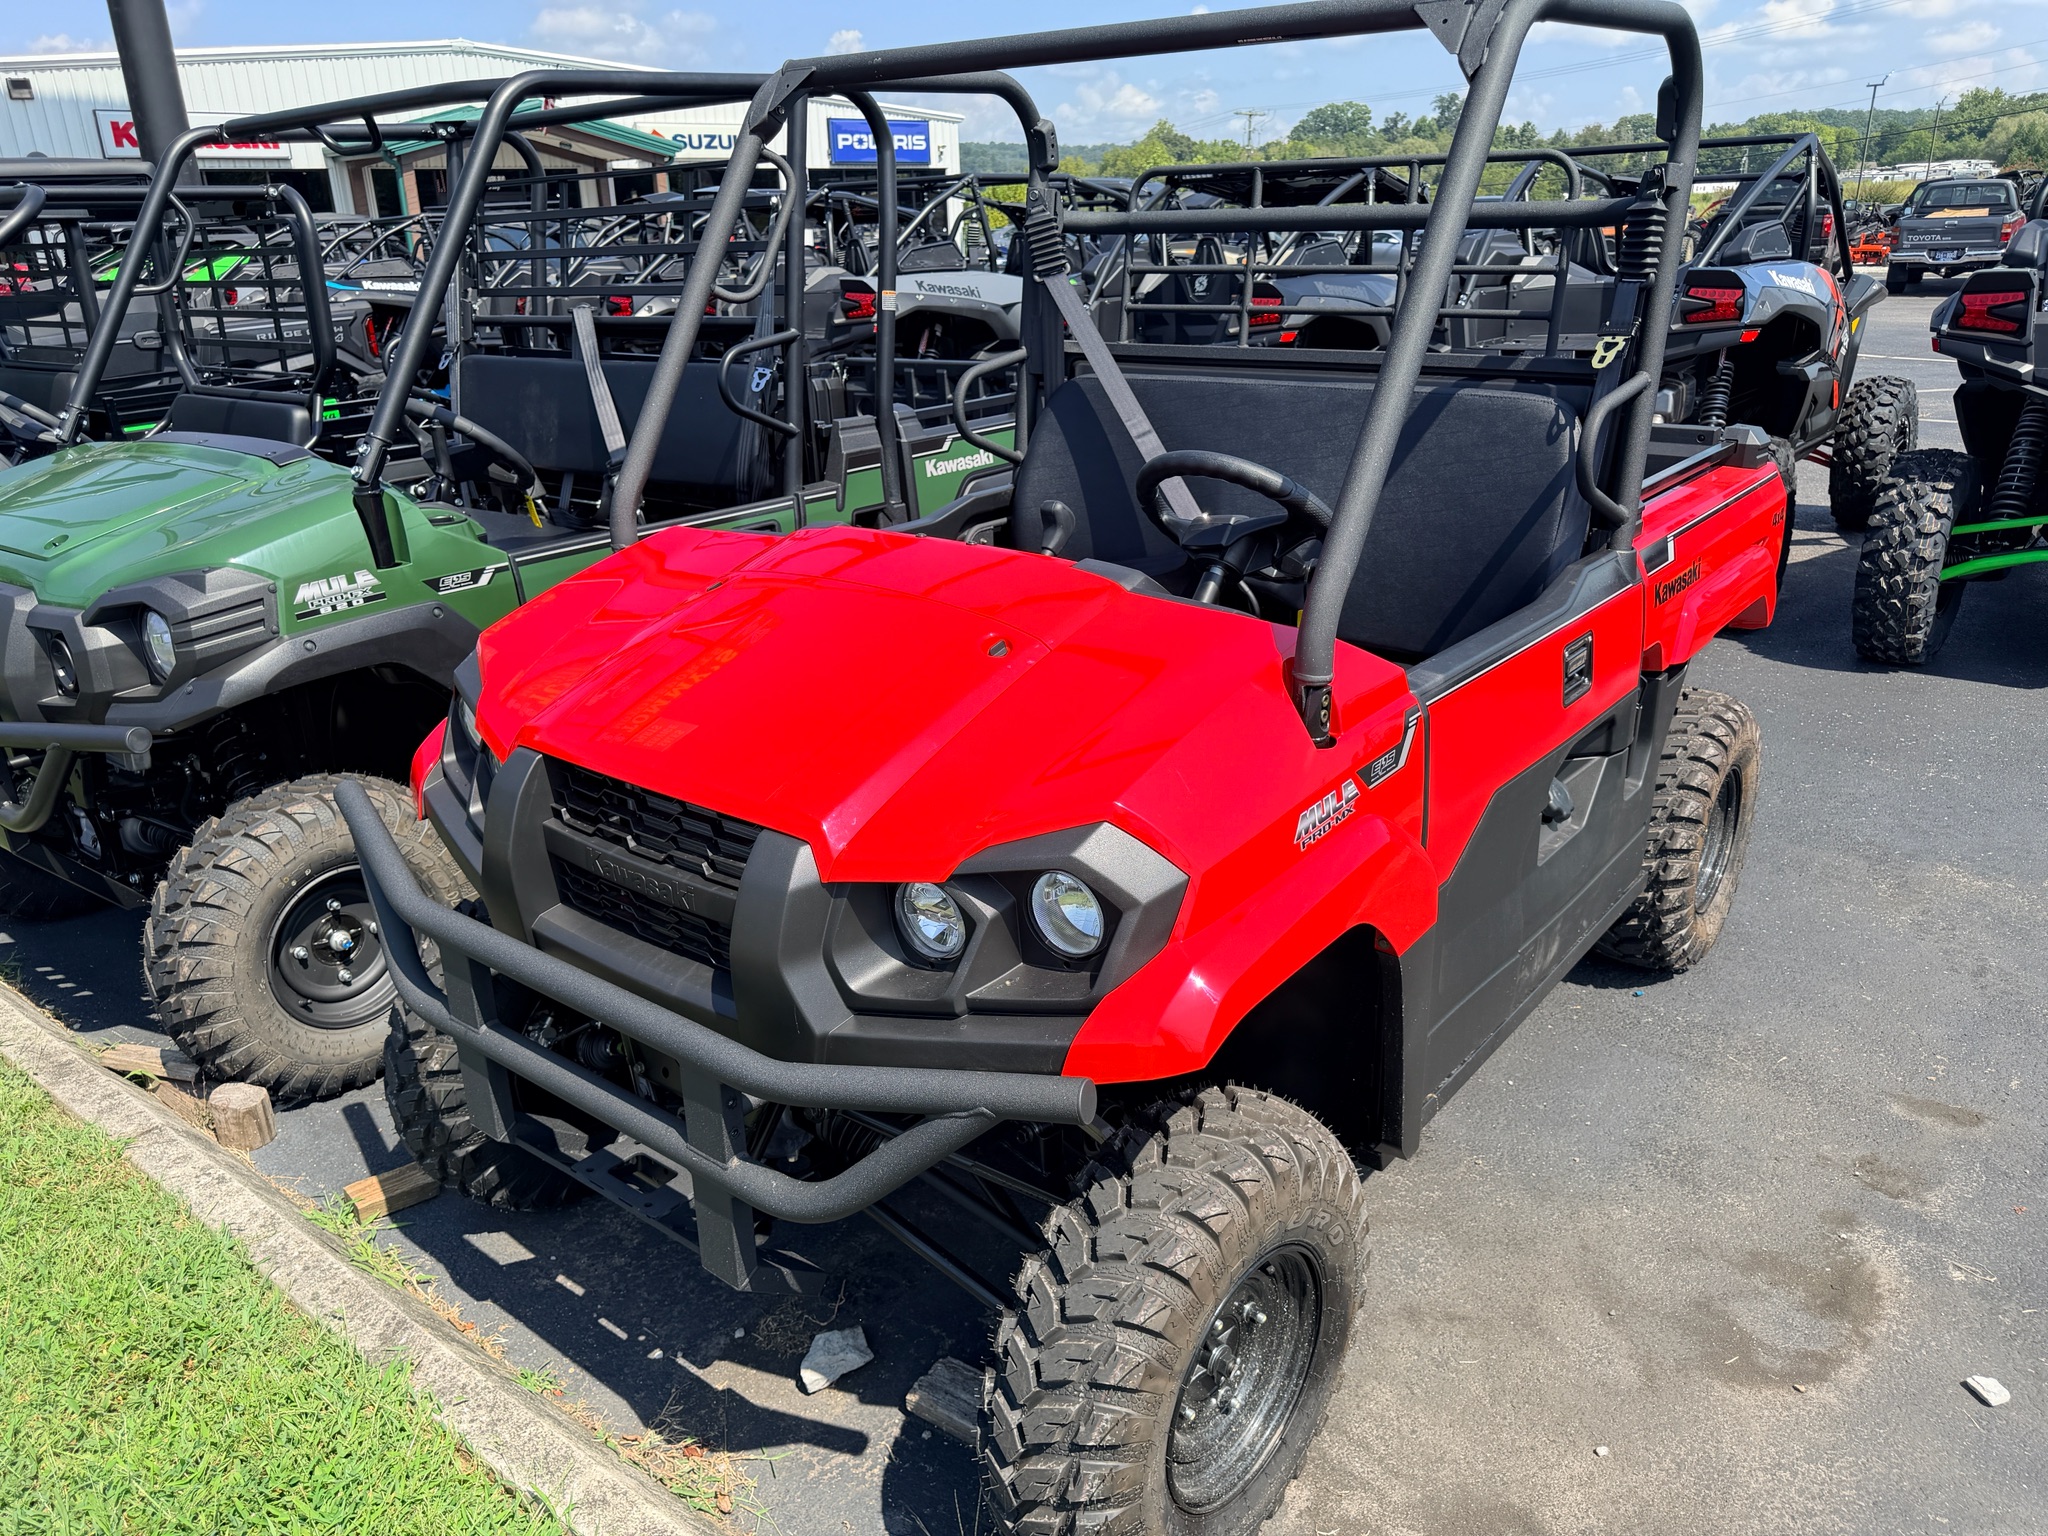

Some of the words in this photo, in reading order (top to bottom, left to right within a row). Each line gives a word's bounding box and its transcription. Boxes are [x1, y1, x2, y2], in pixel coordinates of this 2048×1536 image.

[672, 134, 738, 150] SUZU
[837, 133, 927, 150] POLRIS
[1907, 234, 1942, 242] TOYOTA
[362, 280, 422, 292] Kawasaki
[915, 280, 982, 299] Kawasaki
[1313, 281, 1370, 301] Kawasaki
[1767, 269, 1817, 296] Kawasaki
[925, 448, 995, 478] Kawasaki
[293, 568, 382, 605] MULE
[439, 571, 471, 588] EPS
[1653, 556, 1702, 608] Kawasaki
[1371, 749, 1397, 777] EPS
[1294, 778, 1361, 844] MULE
[1301, 801, 1357, 852] PRO-MX
[585, 845, 697, 912] Kawasaki
